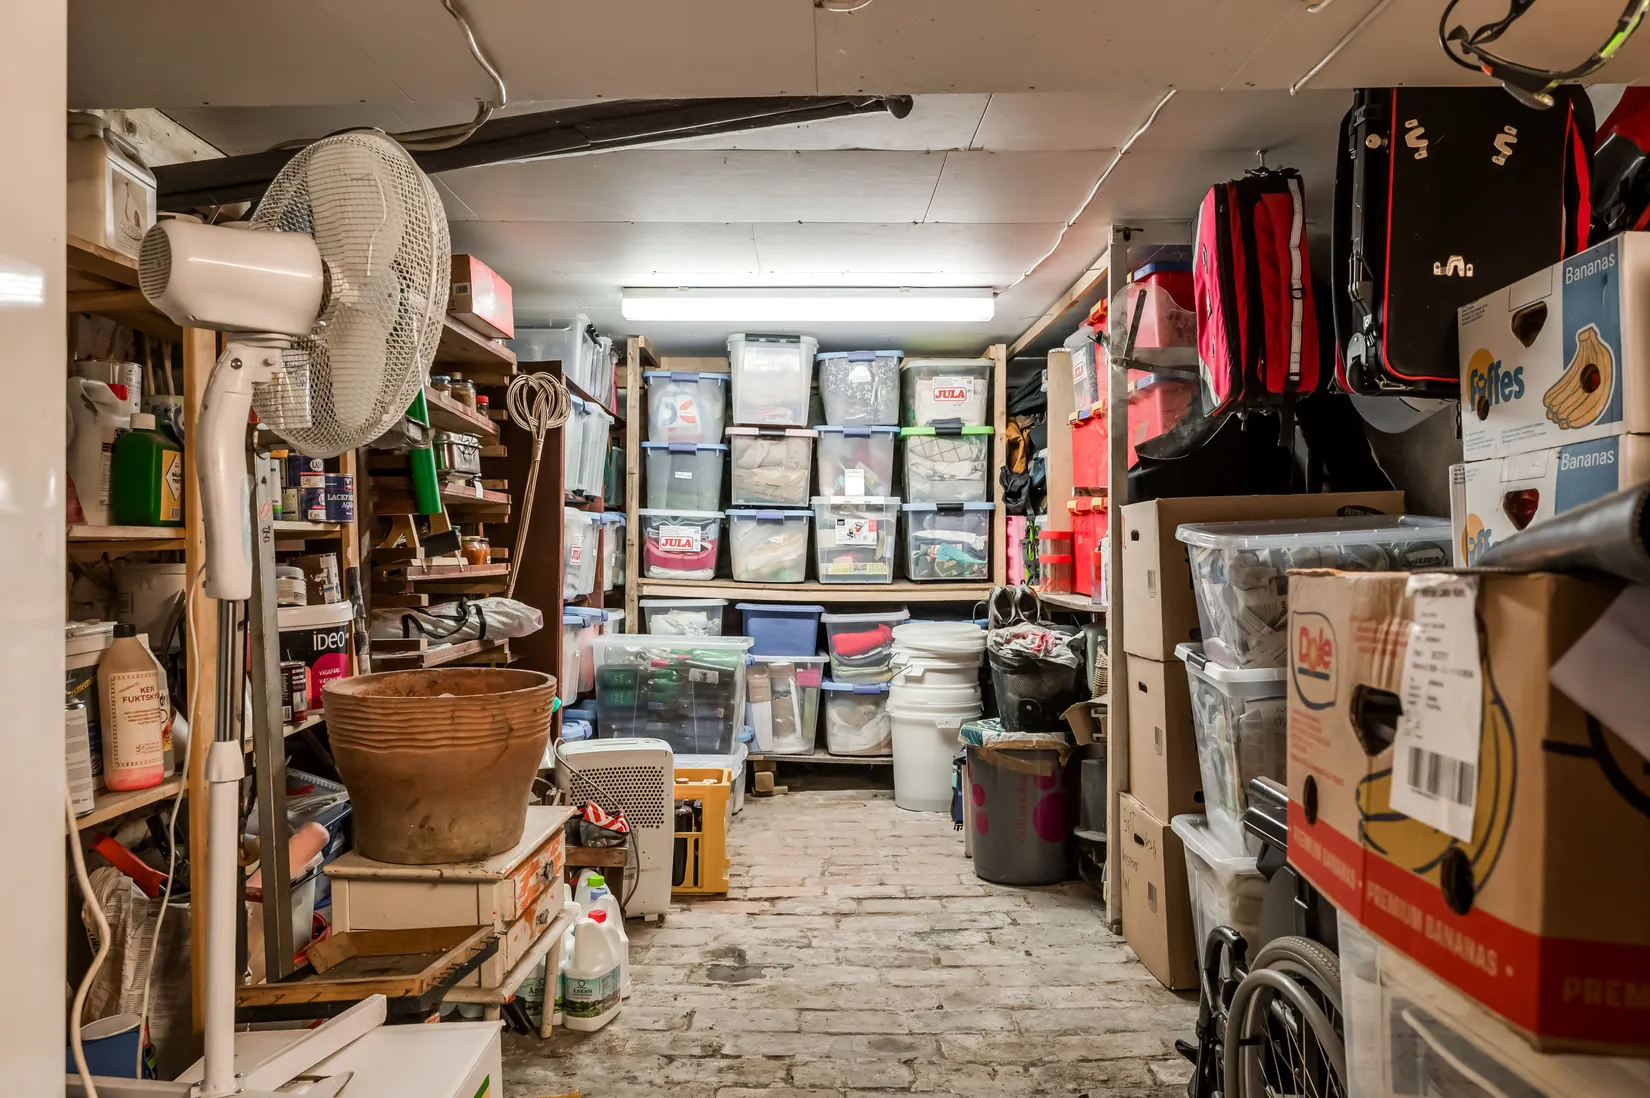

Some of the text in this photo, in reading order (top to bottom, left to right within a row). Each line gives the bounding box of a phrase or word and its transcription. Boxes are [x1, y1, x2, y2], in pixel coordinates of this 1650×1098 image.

[1565, 251, 1616, 285] Bananas
[935, 389, 966, 399] JULA
[1560, 448, 1615, 471] Bananas
[661, 538, 692, 548] JULA
[1299, 625, 1333, 671] Dole
[1366, 880, 1498, 977] PREMIUM BANANAS
